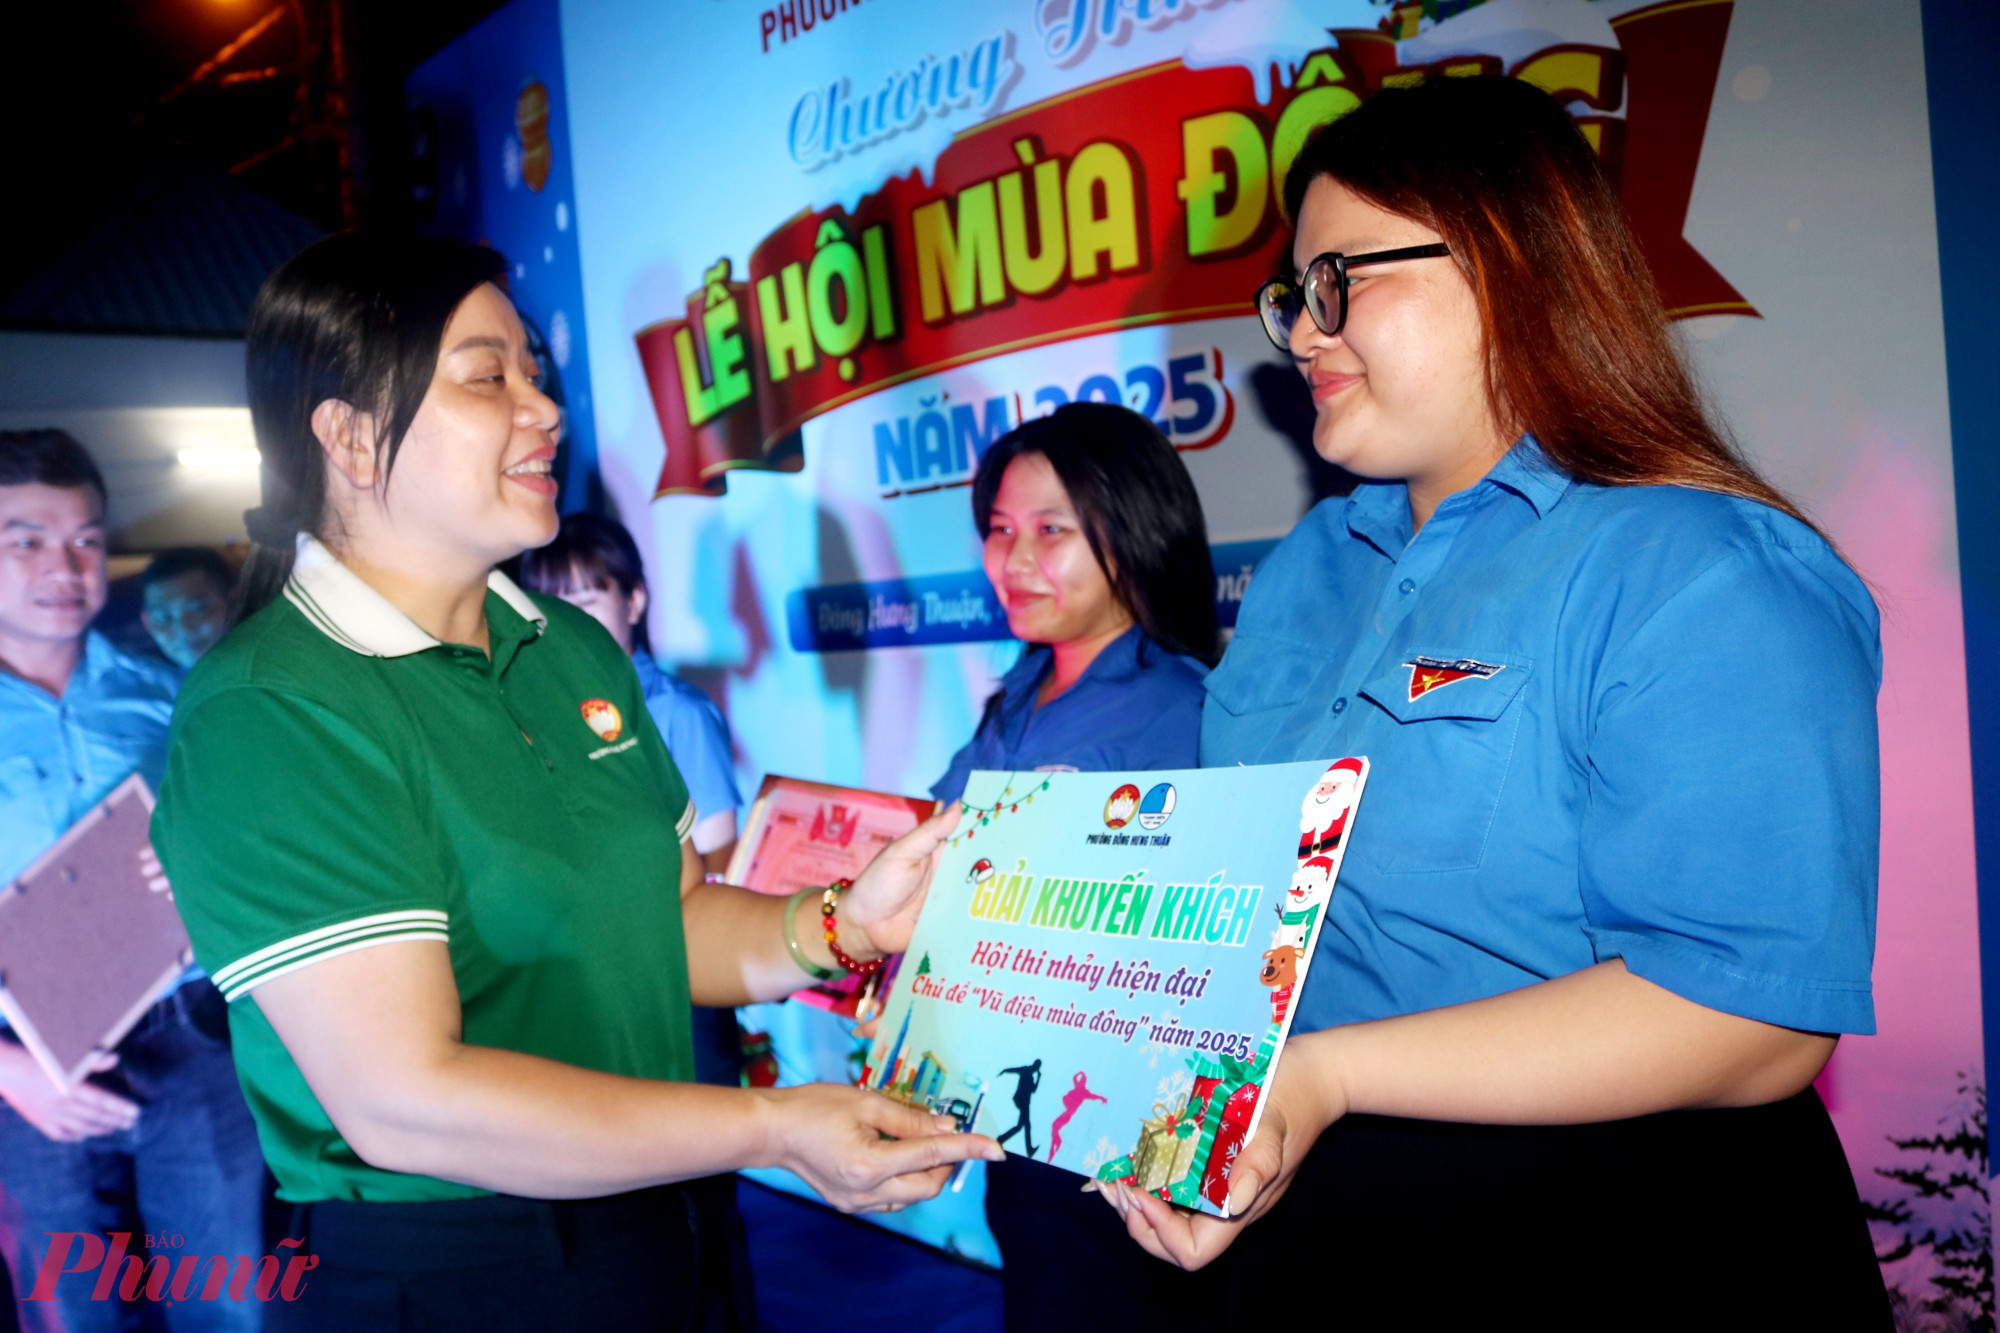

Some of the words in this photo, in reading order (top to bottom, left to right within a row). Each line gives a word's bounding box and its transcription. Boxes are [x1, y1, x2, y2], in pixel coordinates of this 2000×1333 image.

[787, 34, 1008, 167] Chương
[673, 257, 751, 427] LỄ
[757, 218, 895, 382] HỘI
[912, 137, 1139, 323] MÙA
[873, 394, 1012, 487] NĂM
[970, 859, 1034, 924] GIẢI
[1029, 870, 1155, 939] KHUYẾN
[1150, 871, 1263, 947] KHÍCH
[911, 975, 946, 999] Chủ
[945, 981, 971, 1004] đề
[1004, 995, 1044, 1024] điệu
[1045, 1002, 1088, 1029] mùa
[1148, 1018, 1195, 1047] năm
[1196, 1030, 1252, 1061] 2025
[970, 940, 1013, 975] Hội
[1011, 948, 1048, 976] thi
[1046, 953, 1105, 992] nhảy
[1106, 960, 1161, 999] hiện
[1164, 967, 1212, 1006] đại
